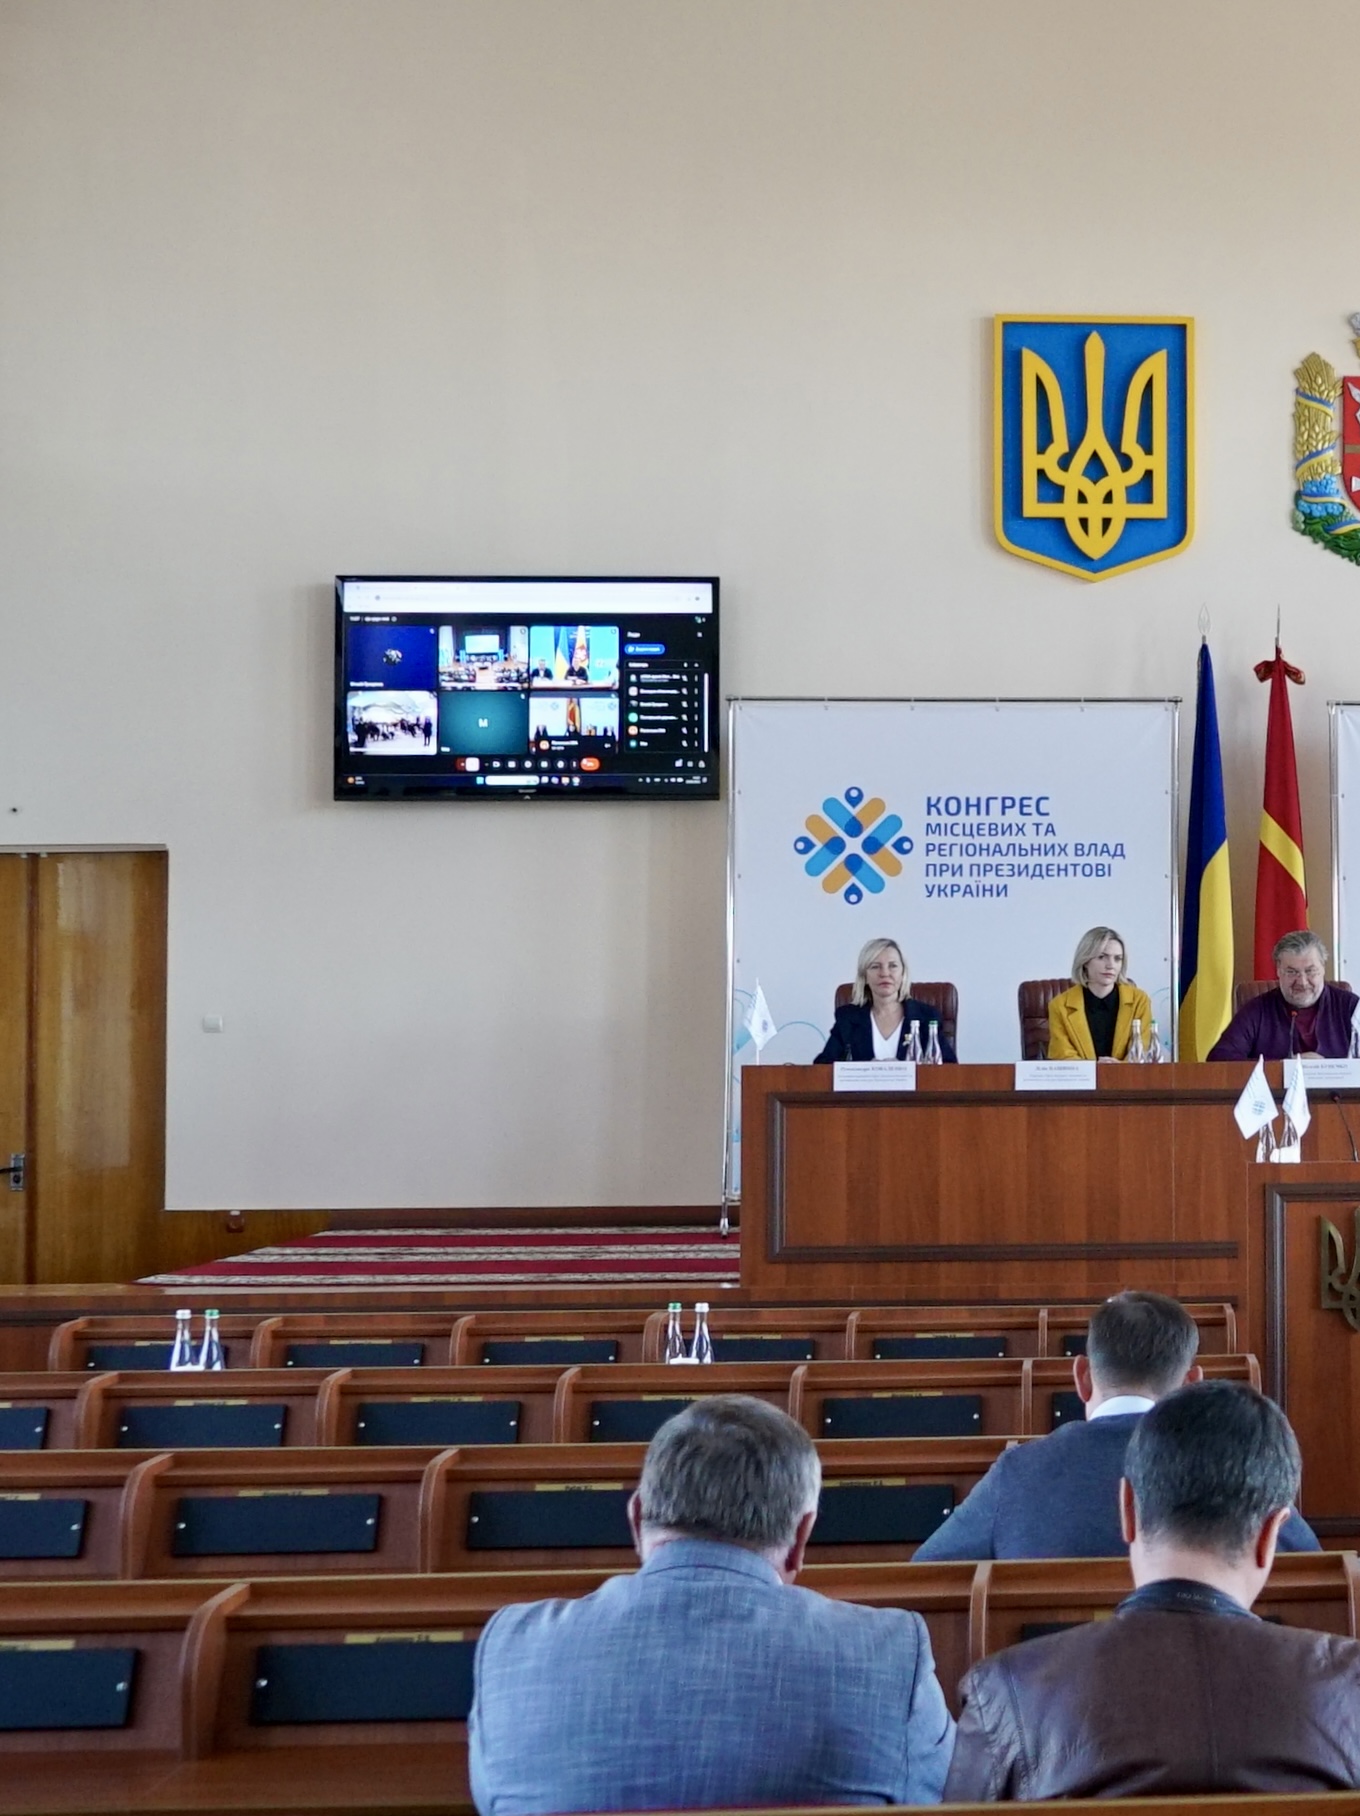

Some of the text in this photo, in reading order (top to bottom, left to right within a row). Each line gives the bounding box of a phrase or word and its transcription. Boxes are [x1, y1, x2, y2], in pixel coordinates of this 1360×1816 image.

[925, 795, 1051, 818] КОНГРЕС
[925, 821, 1057, 840] МІСЦЕВИХ ТА
[924, 842, 1127, 861] РЕГІОНАЛЬНИХ ВЛАД
[924, 862, 1112, 881] ПРИ ПРЕЗИДЕНТОВІ
[924, 879, 1009, 899] УКРАЇНИ
